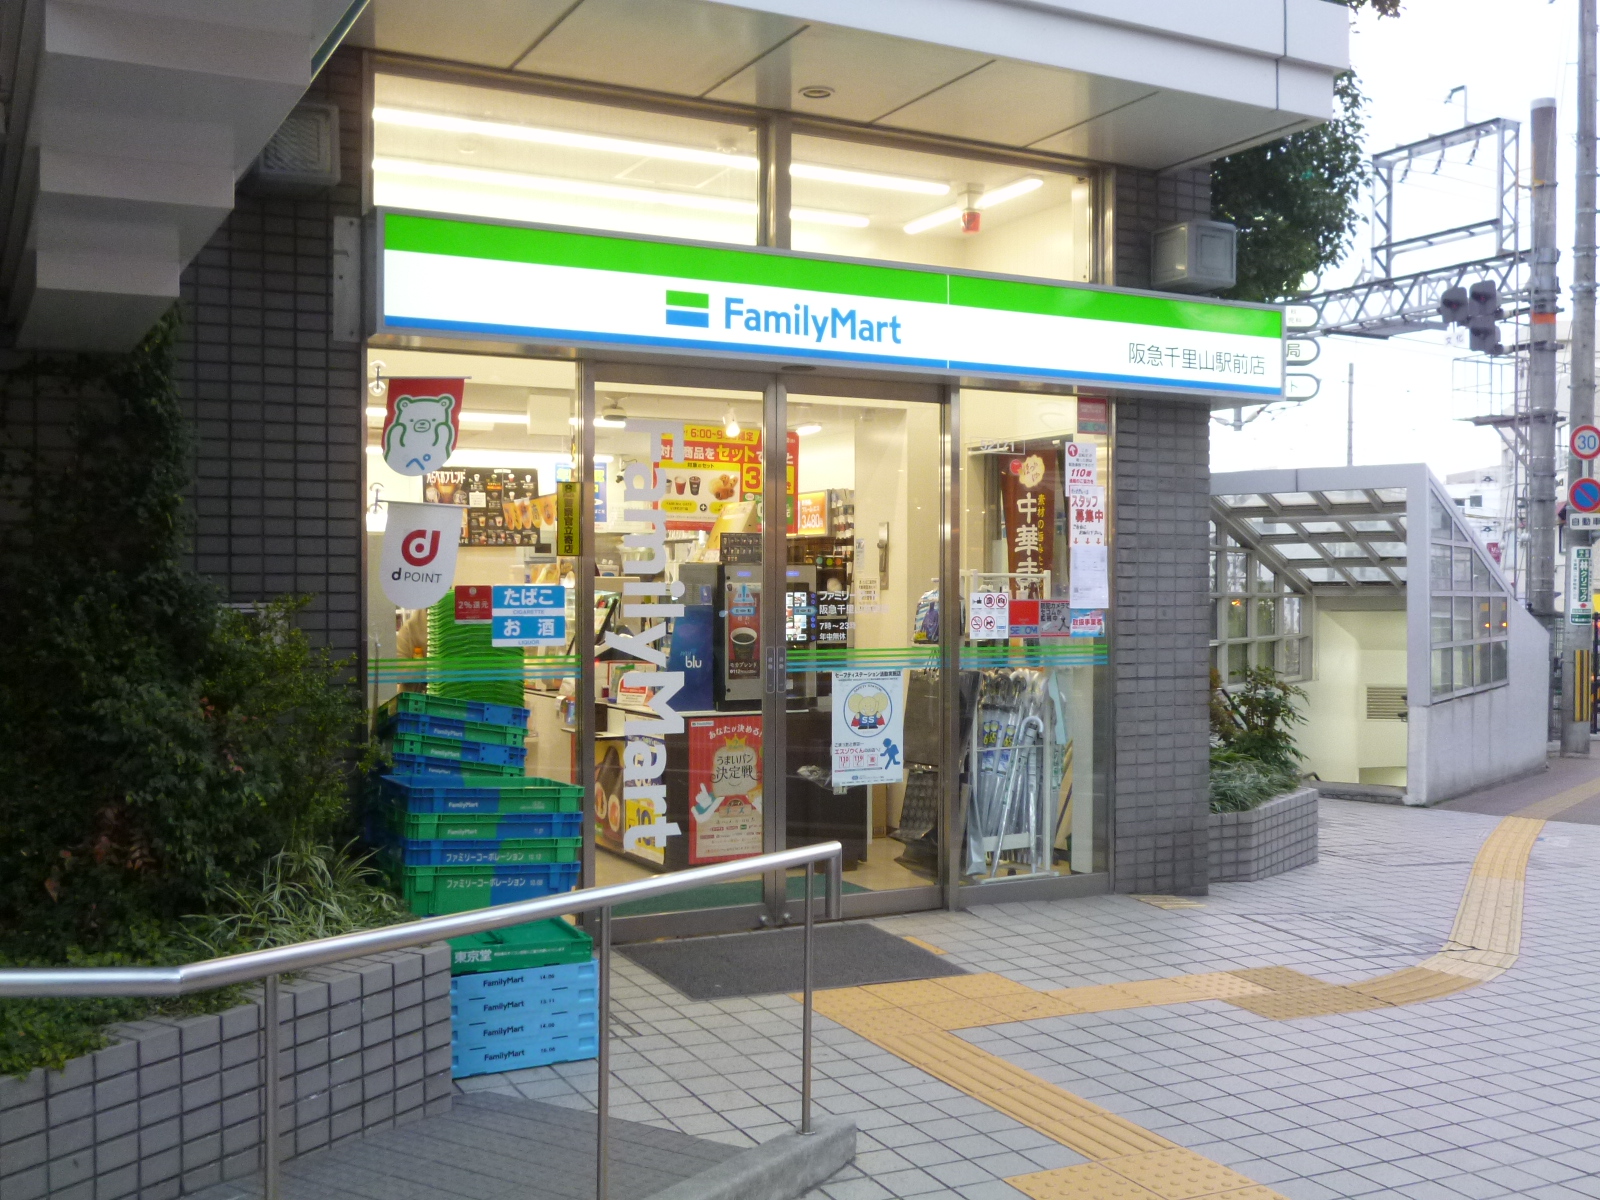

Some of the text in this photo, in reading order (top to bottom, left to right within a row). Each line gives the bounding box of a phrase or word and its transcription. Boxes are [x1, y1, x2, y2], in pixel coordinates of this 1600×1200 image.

[724, 296, 902, 344] FamilyMart
[1286, 343, 1301, 358] 局
[1128, 341, 1266, 376] 阪急千里山駅前店
[1577, 434, 1597, 450] 30
[405, 453, 431, 470] ペ
[1071, 494, 1098, 508] スタッフ
[1075, 509, 1104, 524] 募集中
[1571, 517, 1600, 526] 自動車
[391, 567, 443, 584] d POINT
[503, 588, 555, 606] たばこ
[458, 601, 489, 610] 2%還元
[604, 418, 685, 850] FamilyMart
[819, 632, 847, 641] 年中無休
[685, 655, 702, 669] blu
[861, 716, 875, 724] SS
[433, 727, 463, 738] FamilyMart
[430, 748, 460, 759] FamilyMart
[716, 753, 754, 766] うまいパン
[712, 765, 758, 782] 決定戦
[448, 801, 479, 809] FamilyMart
[447, 828, 478, 836] FamilyMart
[446, 852, 524, 863] ファミリーコーポレーション
[446, 877, 526, 889] ファミリーコーポレーション
[483, 975, 524, 987] FamilyMart
[483, 1001, 525, 1012] FamilyMart
[483, 1025, 524, 1037] FamilyMart
[484, 1050, 525, 1061] FamilyMart
